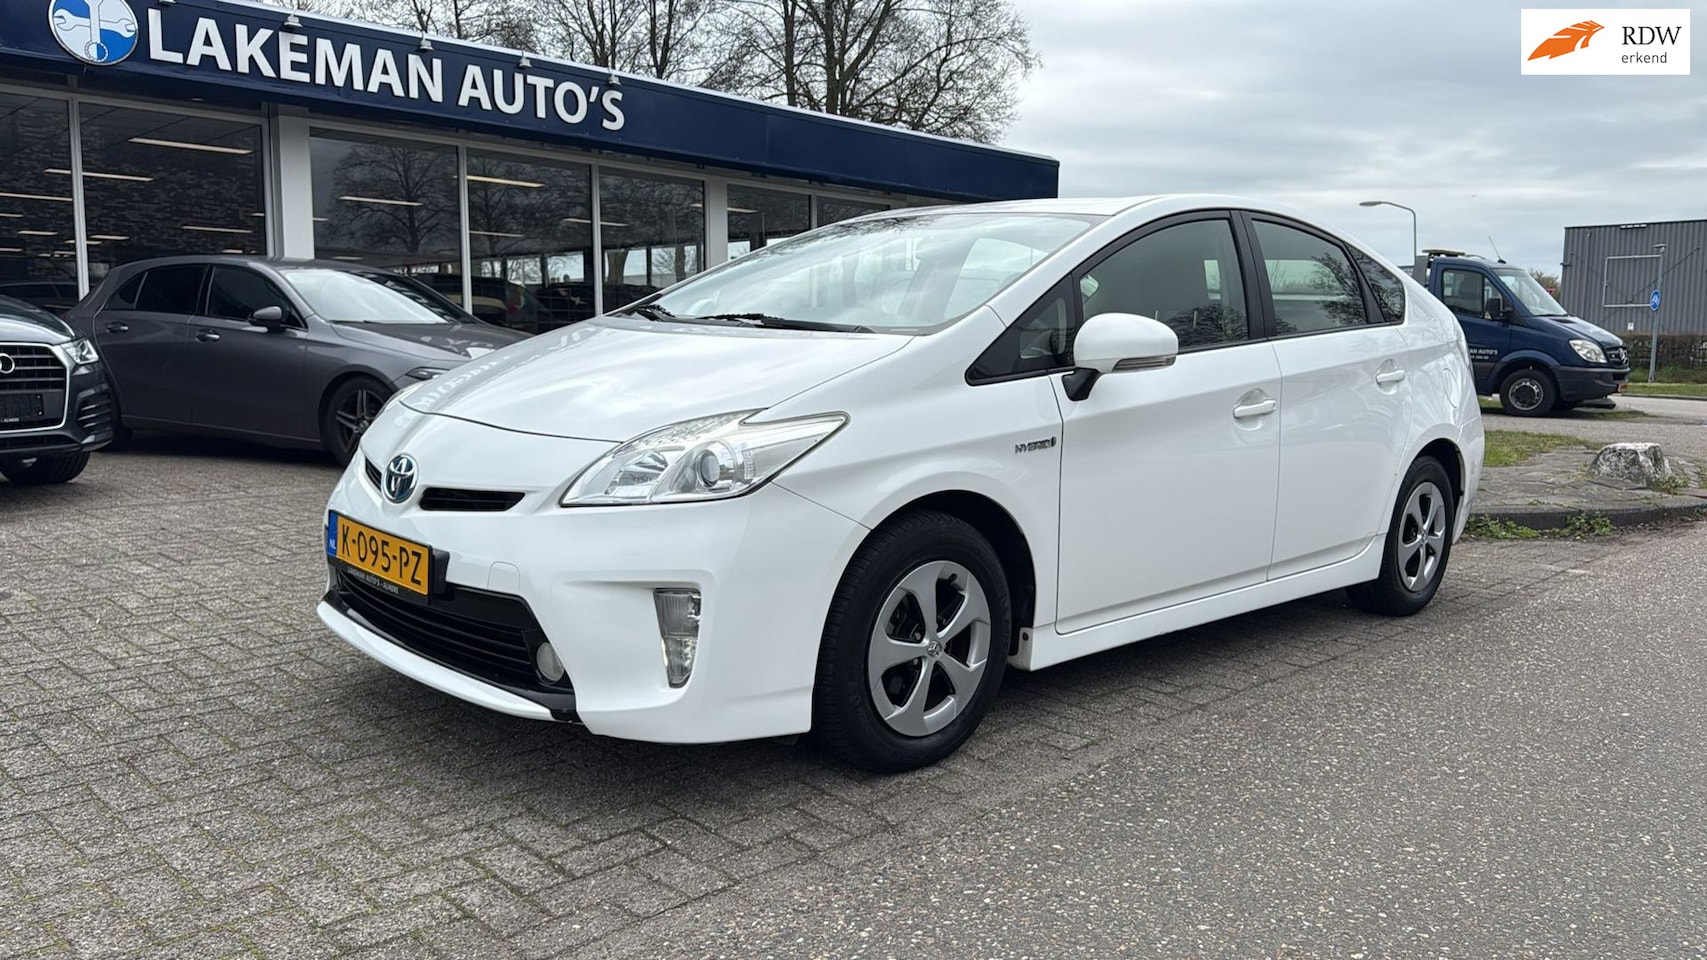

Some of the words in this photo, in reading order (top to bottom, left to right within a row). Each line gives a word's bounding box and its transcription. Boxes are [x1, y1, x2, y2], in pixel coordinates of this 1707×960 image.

[148, 8, 443, 102] LAKEMAN
[457, 64, 625, 131] AUTO'S
[342, 523, 422, 586] K-095-PZ
